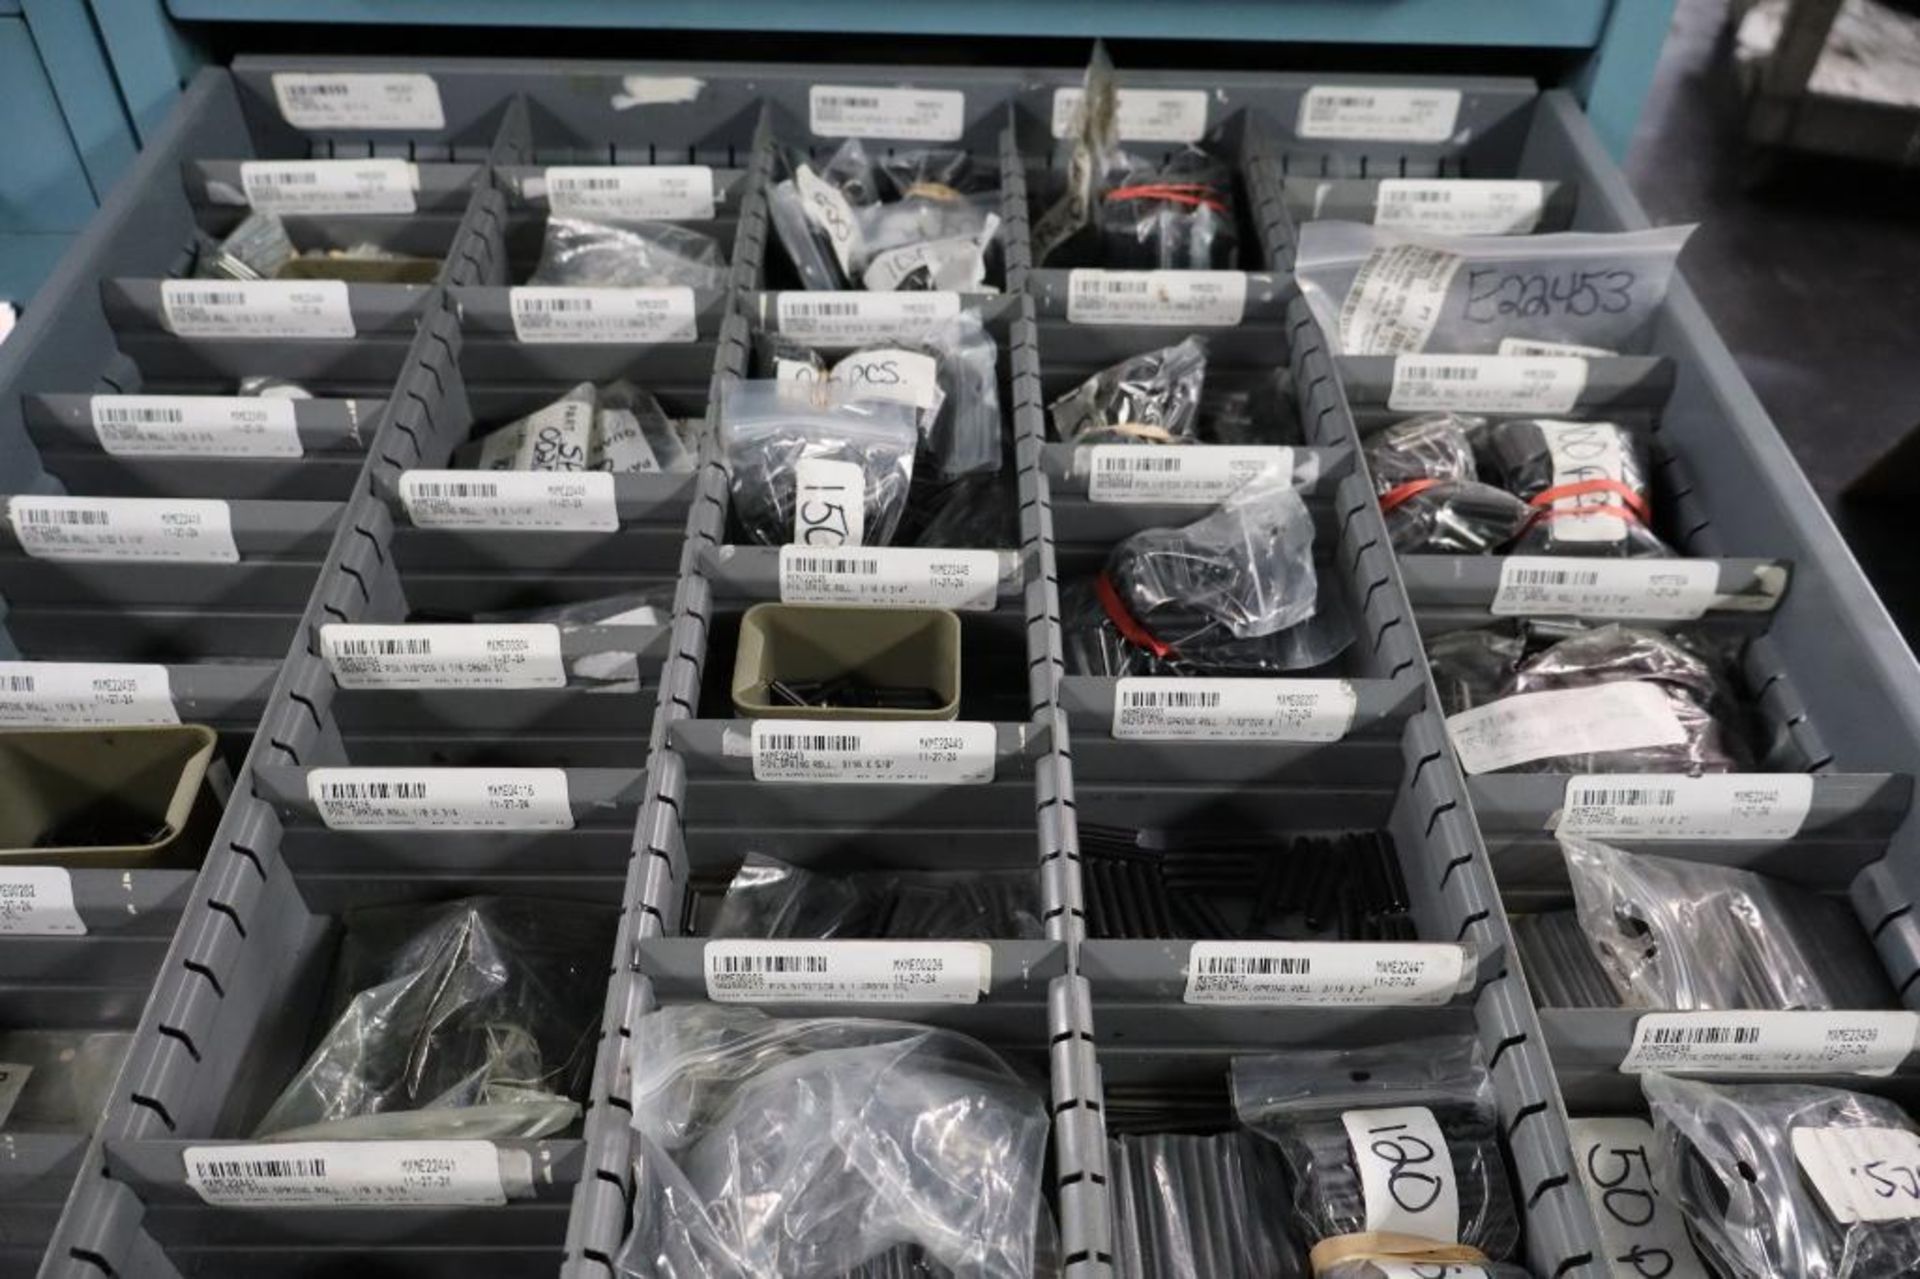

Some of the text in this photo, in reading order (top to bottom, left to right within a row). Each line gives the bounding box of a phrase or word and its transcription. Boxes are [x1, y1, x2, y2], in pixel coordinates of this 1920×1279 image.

[1462, 269, 1637, 324] E22453
[918, 752, 957, 762] 11-27-24
[487, 784, 535, 797] MXME04116
[490, 799, 530, 810] 11-27-24
[1375, 960, 1425, 974] MXME22447
[894, 973, 937, 985] 11-27-24
[1374, 977, 1416, 987] 11-27-24
[401, 1159, 457, 1173] MXME22441
[1368, 1124, 1442, 1213] 120
[1588, 1144, 1658, 1226] 50
